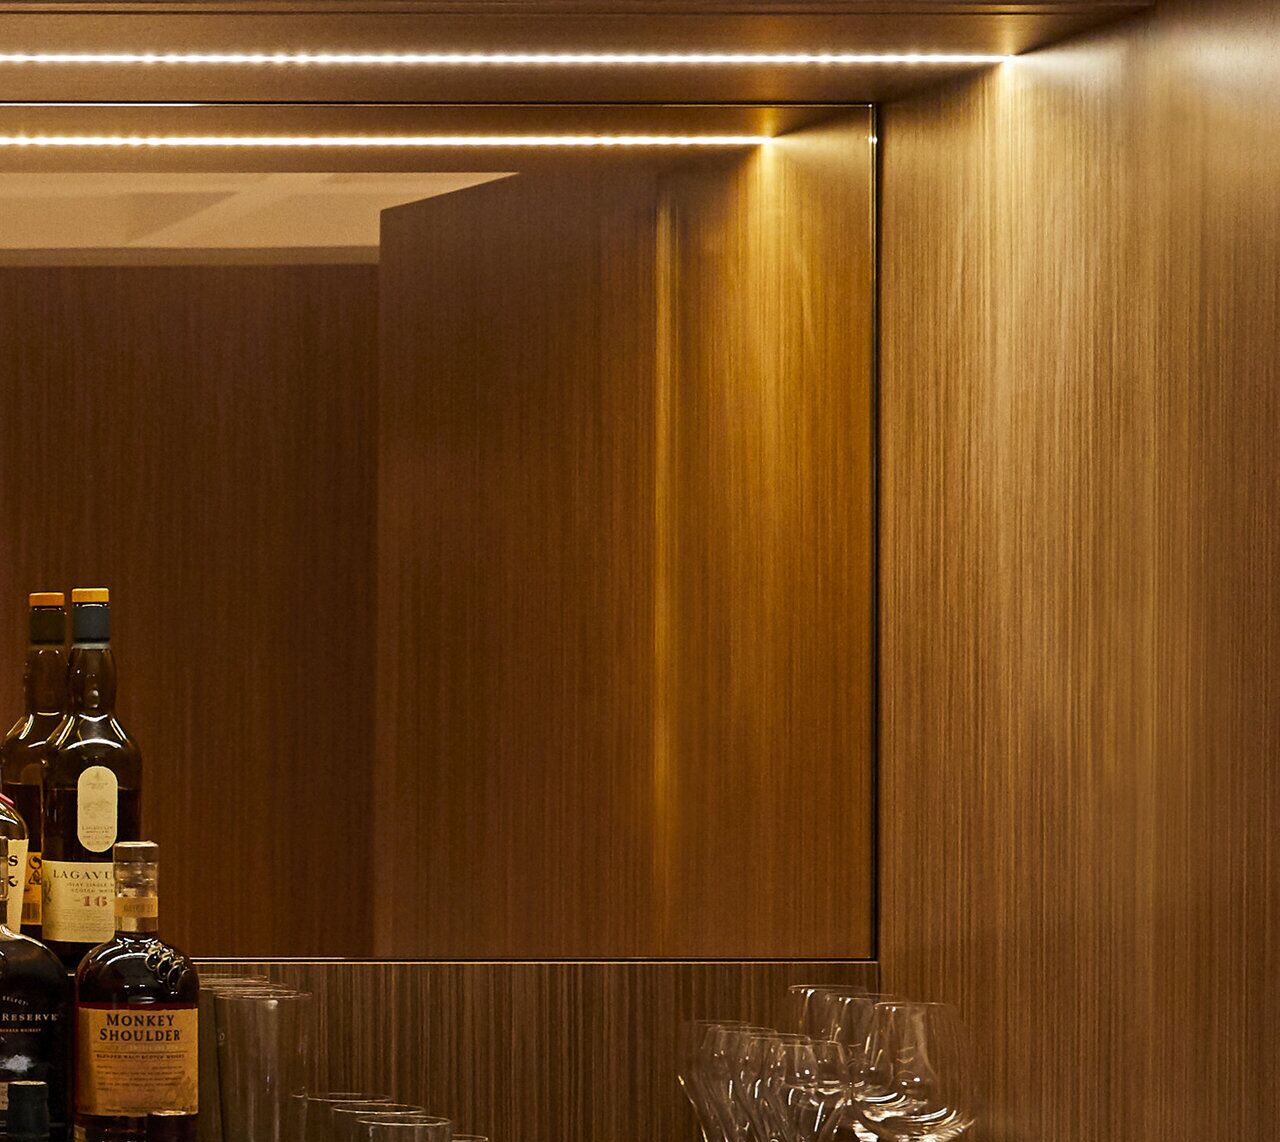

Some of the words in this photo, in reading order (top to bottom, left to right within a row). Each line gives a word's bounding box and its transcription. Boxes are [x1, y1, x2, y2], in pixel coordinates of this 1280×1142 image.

[82, 896, 109, 907] 16
[2, 1012, 58, 1021] RESERVE
[106, 1013, 175, 1027] MONKEY
[99, 1028, 181, 1042] SHOULDER
